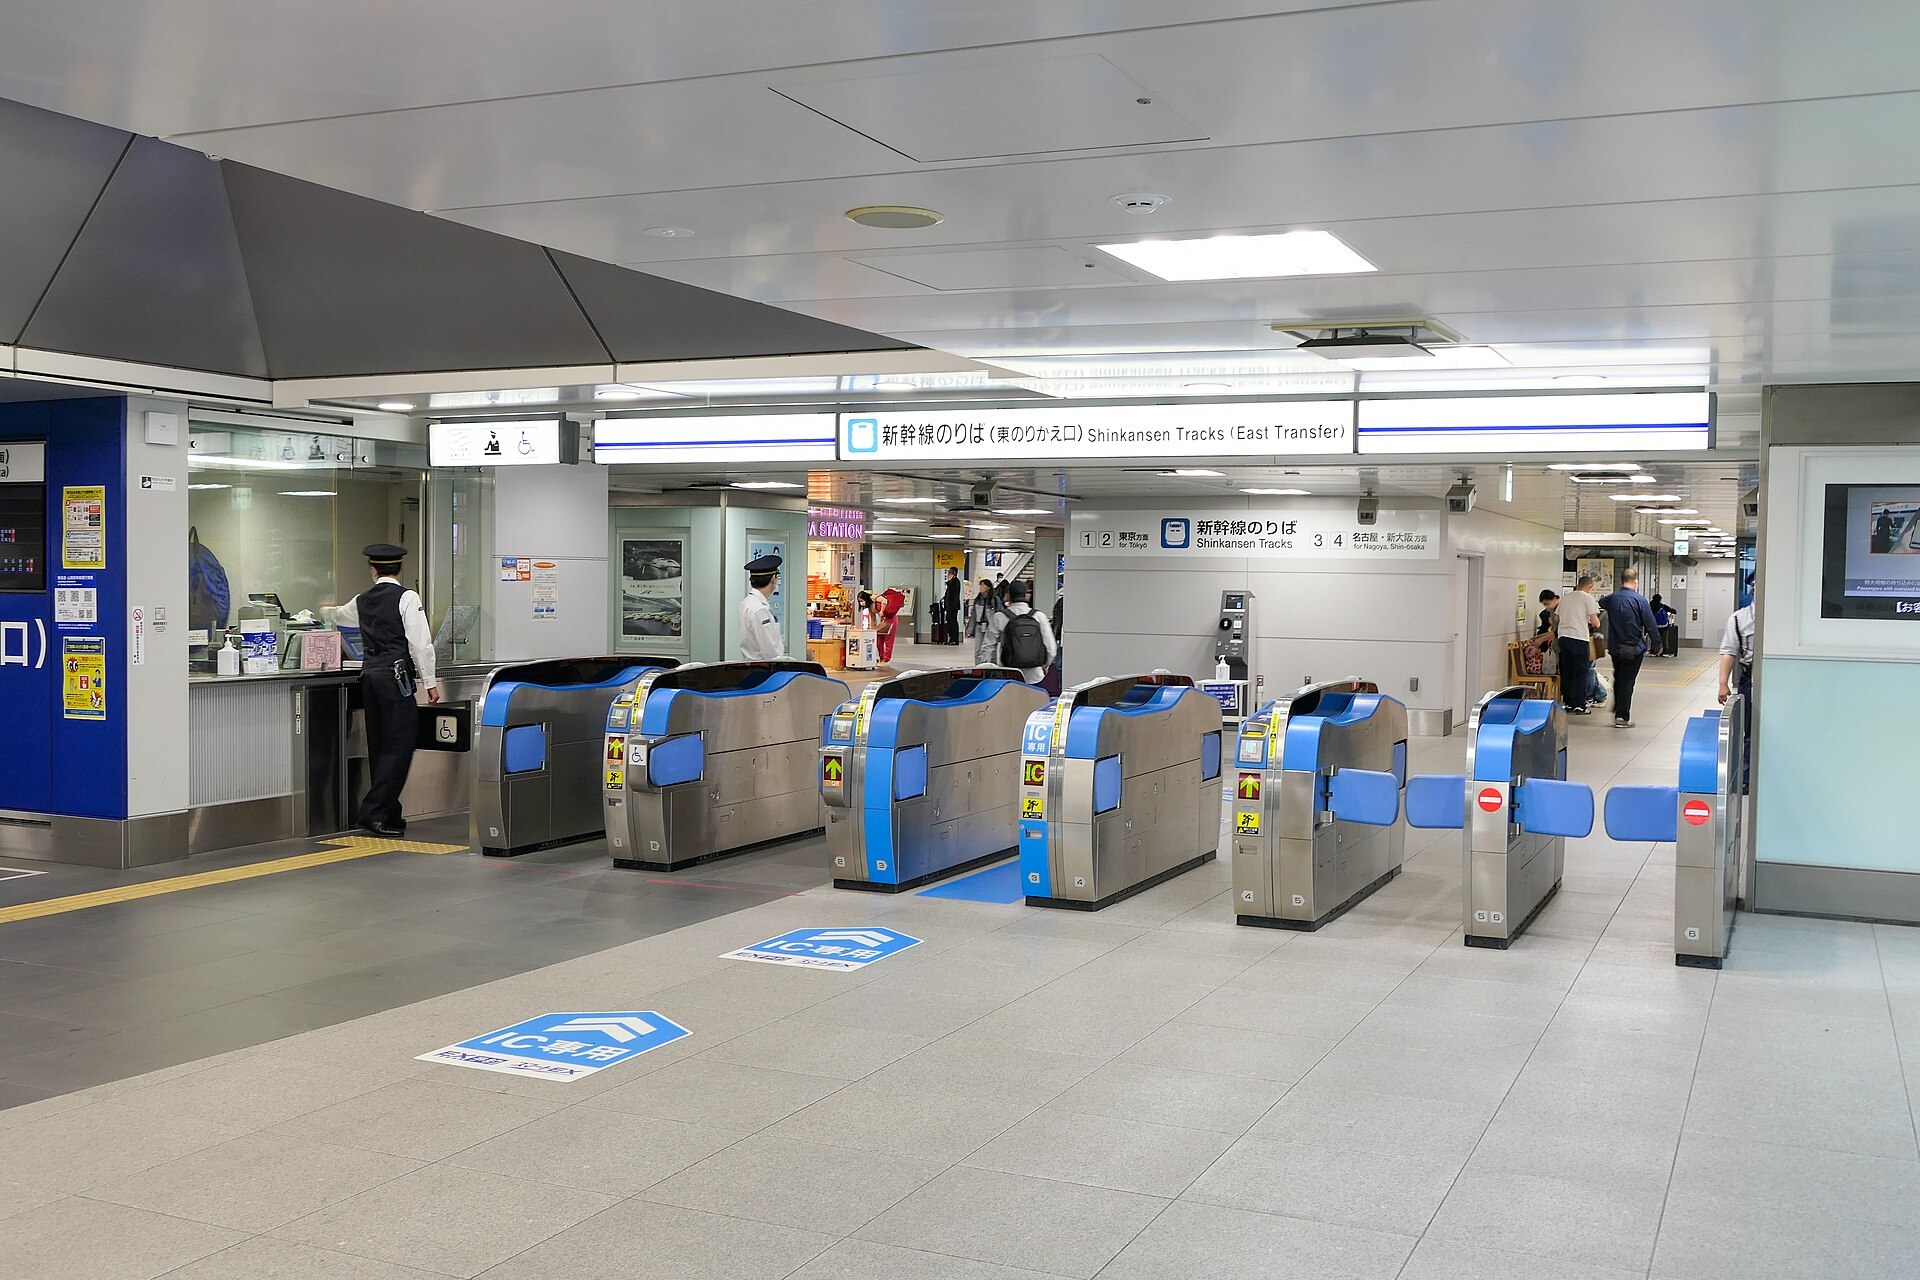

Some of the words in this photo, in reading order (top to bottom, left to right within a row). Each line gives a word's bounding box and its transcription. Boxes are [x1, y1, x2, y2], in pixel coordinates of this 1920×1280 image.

[882, 423, 985, 446] 新幹線のりば
[989, 424, 1083, 444] (東のりかえ口)
[1087, 428, 1170, 443] Shinkansen
[1176, 426, 1225, 441] Tracks
[1230, 425, 1269, 441] (East
[1274, 424, 1345, 440] Transfer)
[819, 521, 863, 538] STATION
[1196, 520, 1298, 535] 新幹線のりば
[1084, 533, 1090, 546] 1
[1102, 533, 1111, 546] 2
[1118, 531, 1149, 541] 東京方面
[1196, 537, 1256, 548] Shinkansen
[1259, 538, 1293, 548] Tracks
[1313, 533, 1323, 546] 3
[1333, 534, 1343, 546] 4
[1363, 543, 1389, 551] Nagoya,
[0, 618, 47, 669] 口)
[1028, 724, 1048, 741] IC
[1026, 742, 1046, 753] 専用
[1024, 763, 1045, 783] IC
[762, 940, 884, 959] IC専用
[480, 1031, 632, 1063] IC専用
